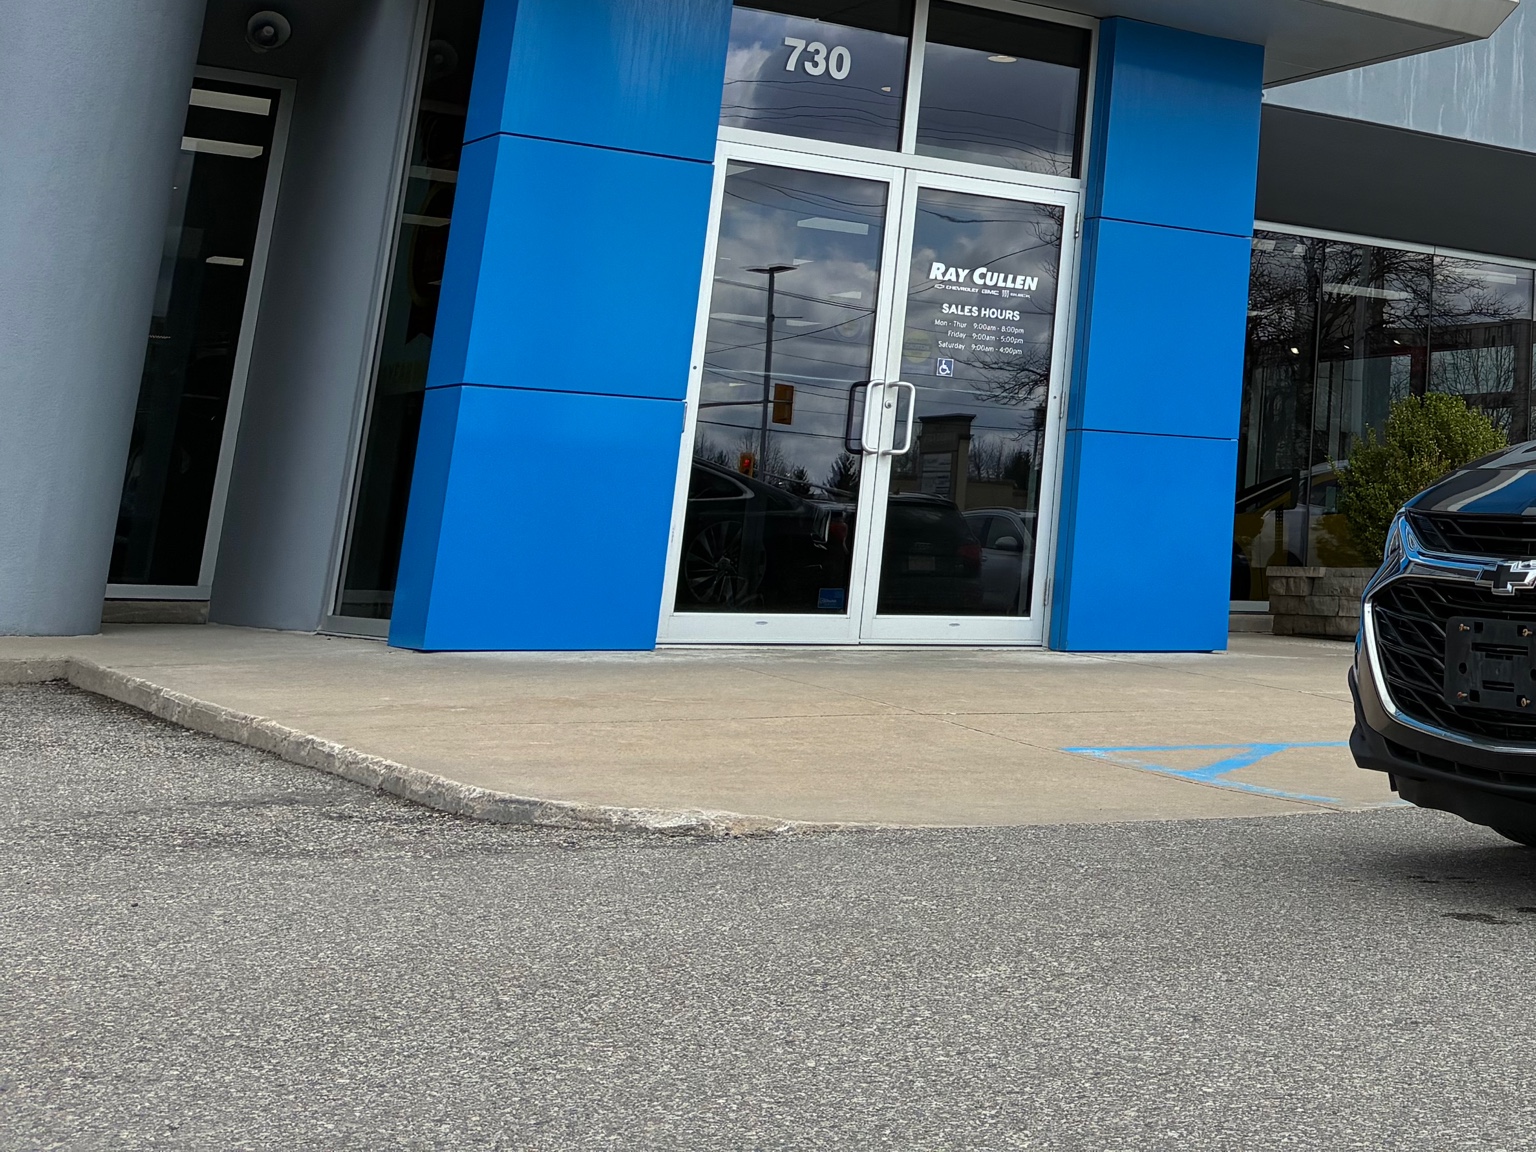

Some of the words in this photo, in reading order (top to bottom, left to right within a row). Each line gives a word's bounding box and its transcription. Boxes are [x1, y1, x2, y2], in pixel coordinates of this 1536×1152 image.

[784, 36, 851, 80] 730
[946, 285, 979, 293] CHEVROLET
[942, 303, 978, 316] SALES
[981, 308, 1020, 321] HOURS
[934, 319, 948, 327] Mon
[953, 320, 967, 328] Thur
[947, 330, 967, 339] Friday
[972, 333, 995, 341] 9:00am
[938, 341, 966, 351] Saturday
[971, 344, 994, 352] 9:00am
